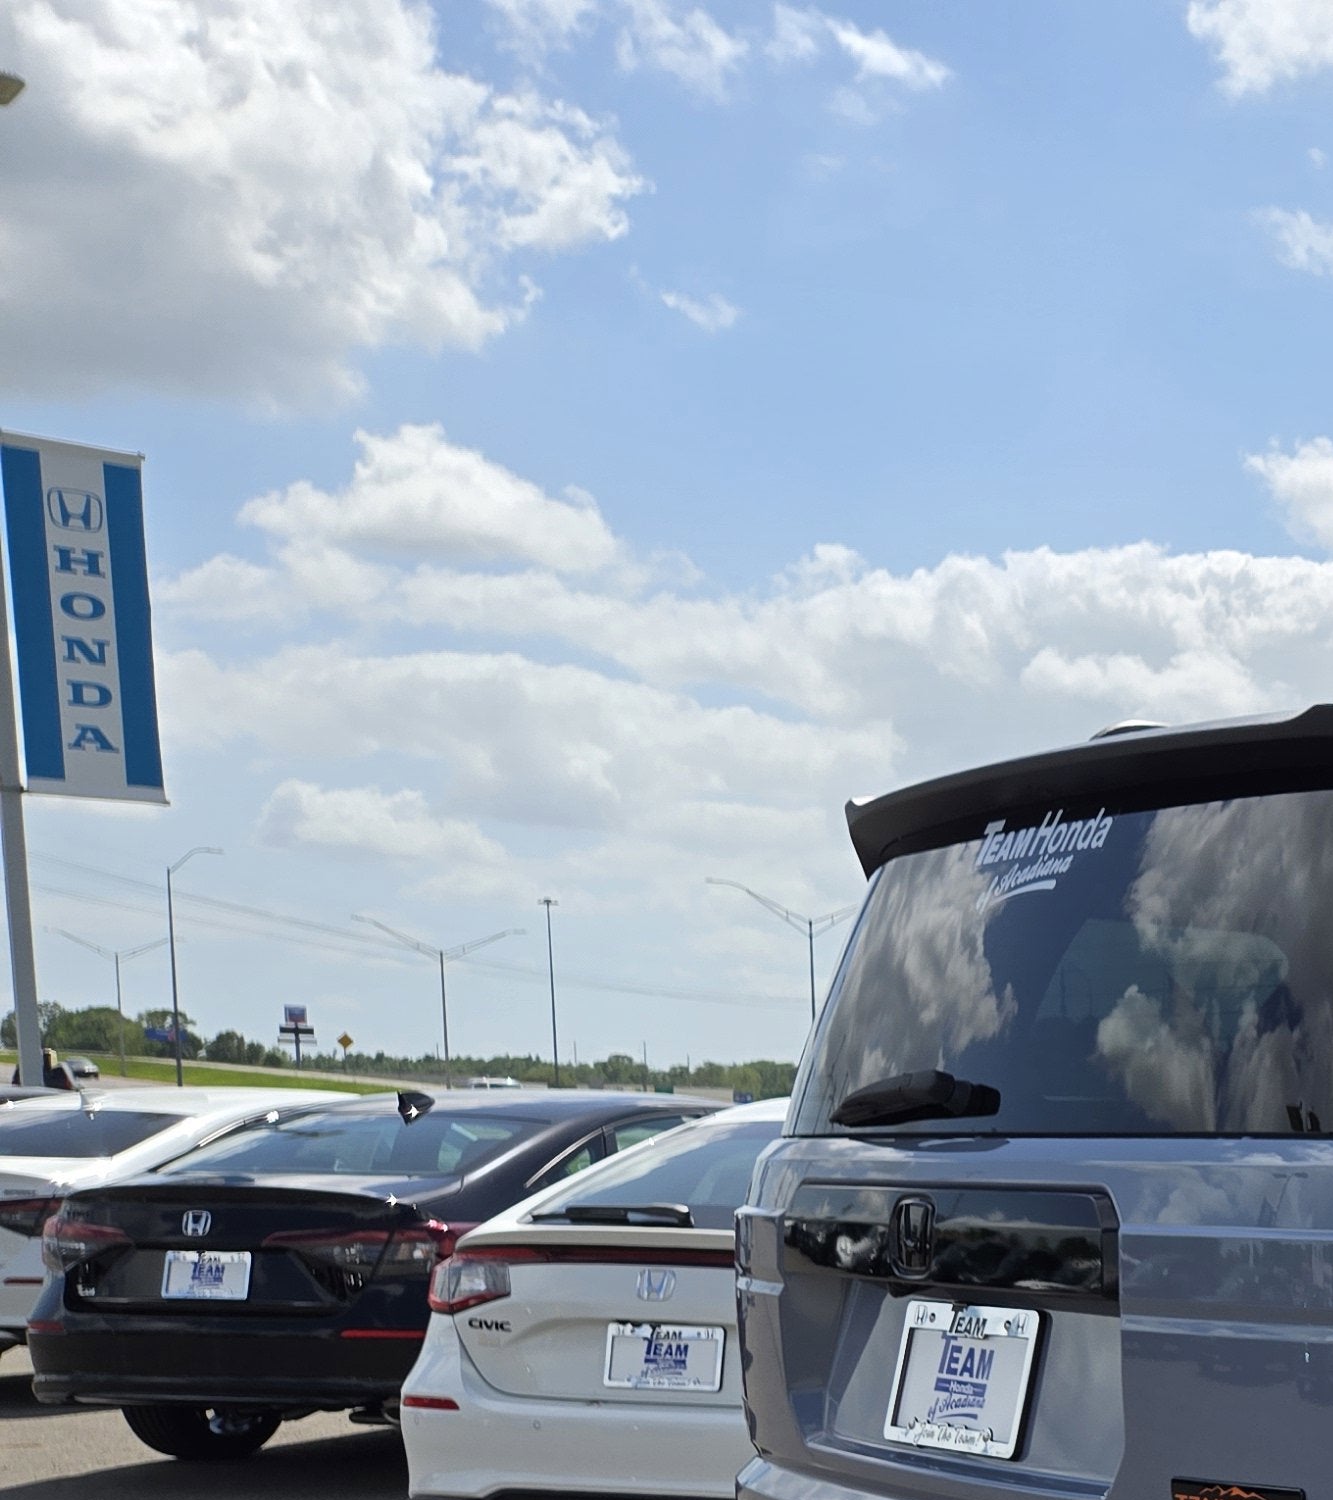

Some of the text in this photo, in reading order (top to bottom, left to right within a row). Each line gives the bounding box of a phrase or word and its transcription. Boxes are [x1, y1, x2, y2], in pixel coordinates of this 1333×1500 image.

[53, 543, 119, 754] HONDA
[468, 1317, 512, 1333] CIVIC
[948, 1303, 988, 1339] TEAM
[938, 1332, 995, 1381] TEAM
